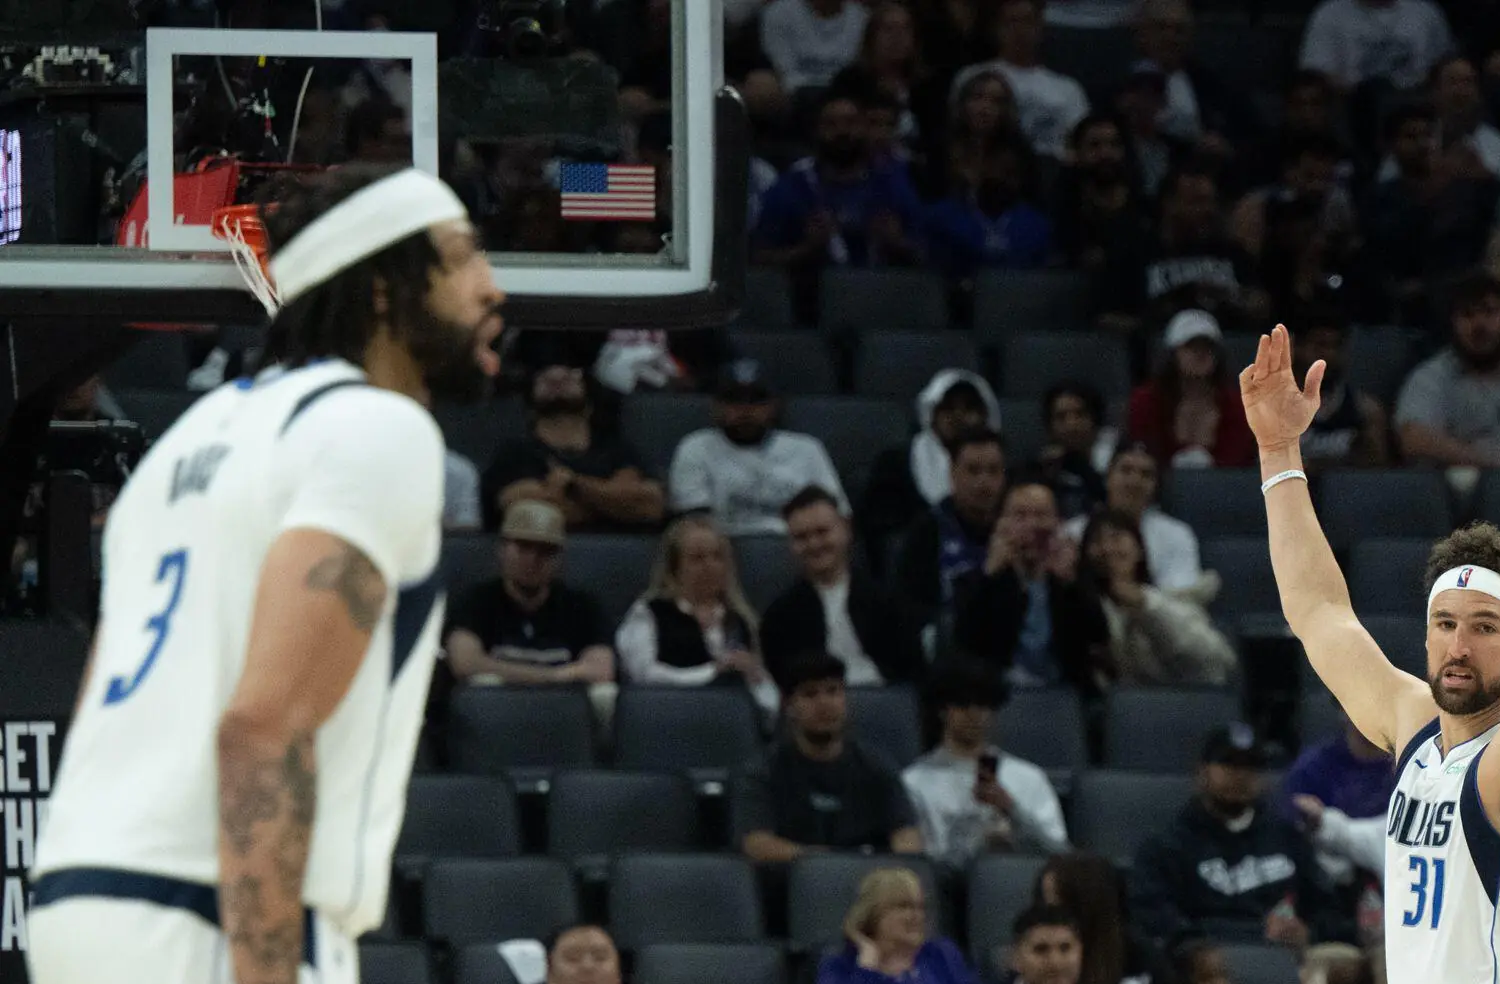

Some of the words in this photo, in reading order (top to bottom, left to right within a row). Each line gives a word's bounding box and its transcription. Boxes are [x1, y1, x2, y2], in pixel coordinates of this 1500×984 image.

[103, 548, 188, 706] 3
[0, 721, 55, 792] ET
[1402, 854, 1446, 930] 31
